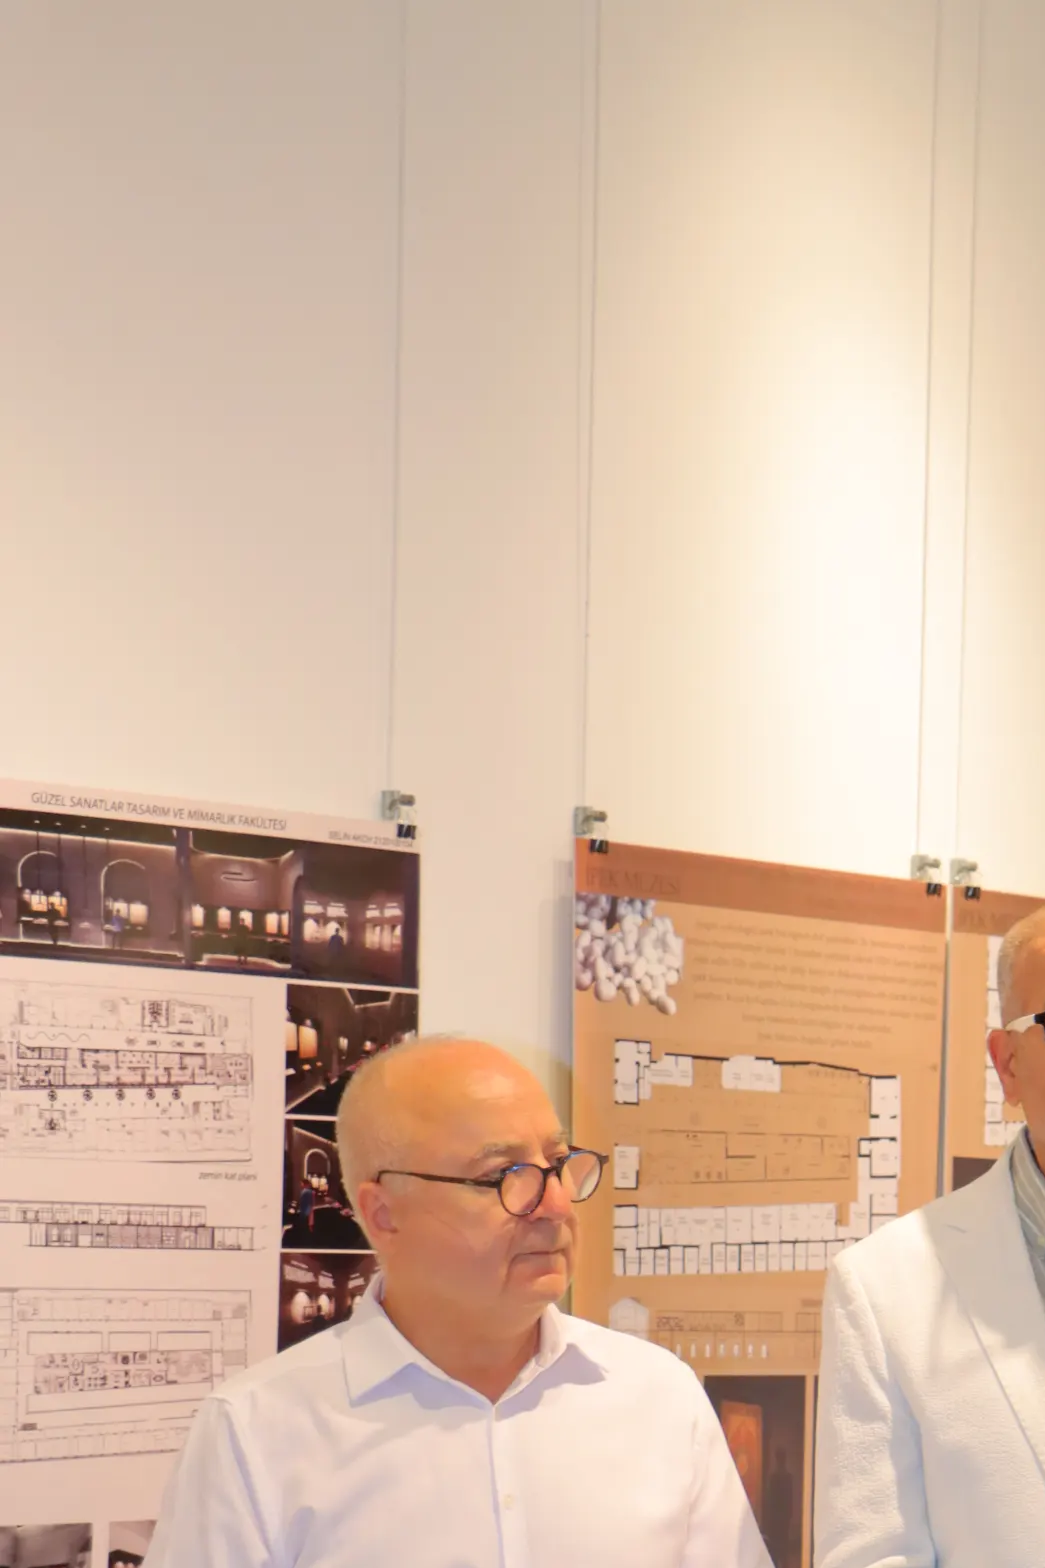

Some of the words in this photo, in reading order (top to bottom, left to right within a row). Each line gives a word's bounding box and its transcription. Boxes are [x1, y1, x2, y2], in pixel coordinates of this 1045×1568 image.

[31, 791, 66, 807] GÜZEL
[69, 795, 124, 813] SANATLAR
[126, 802, 171, 817] TASARIM
[172, 808, 185, 820] VE
[238, 814, 287, 831] FAKÜLTESİ
